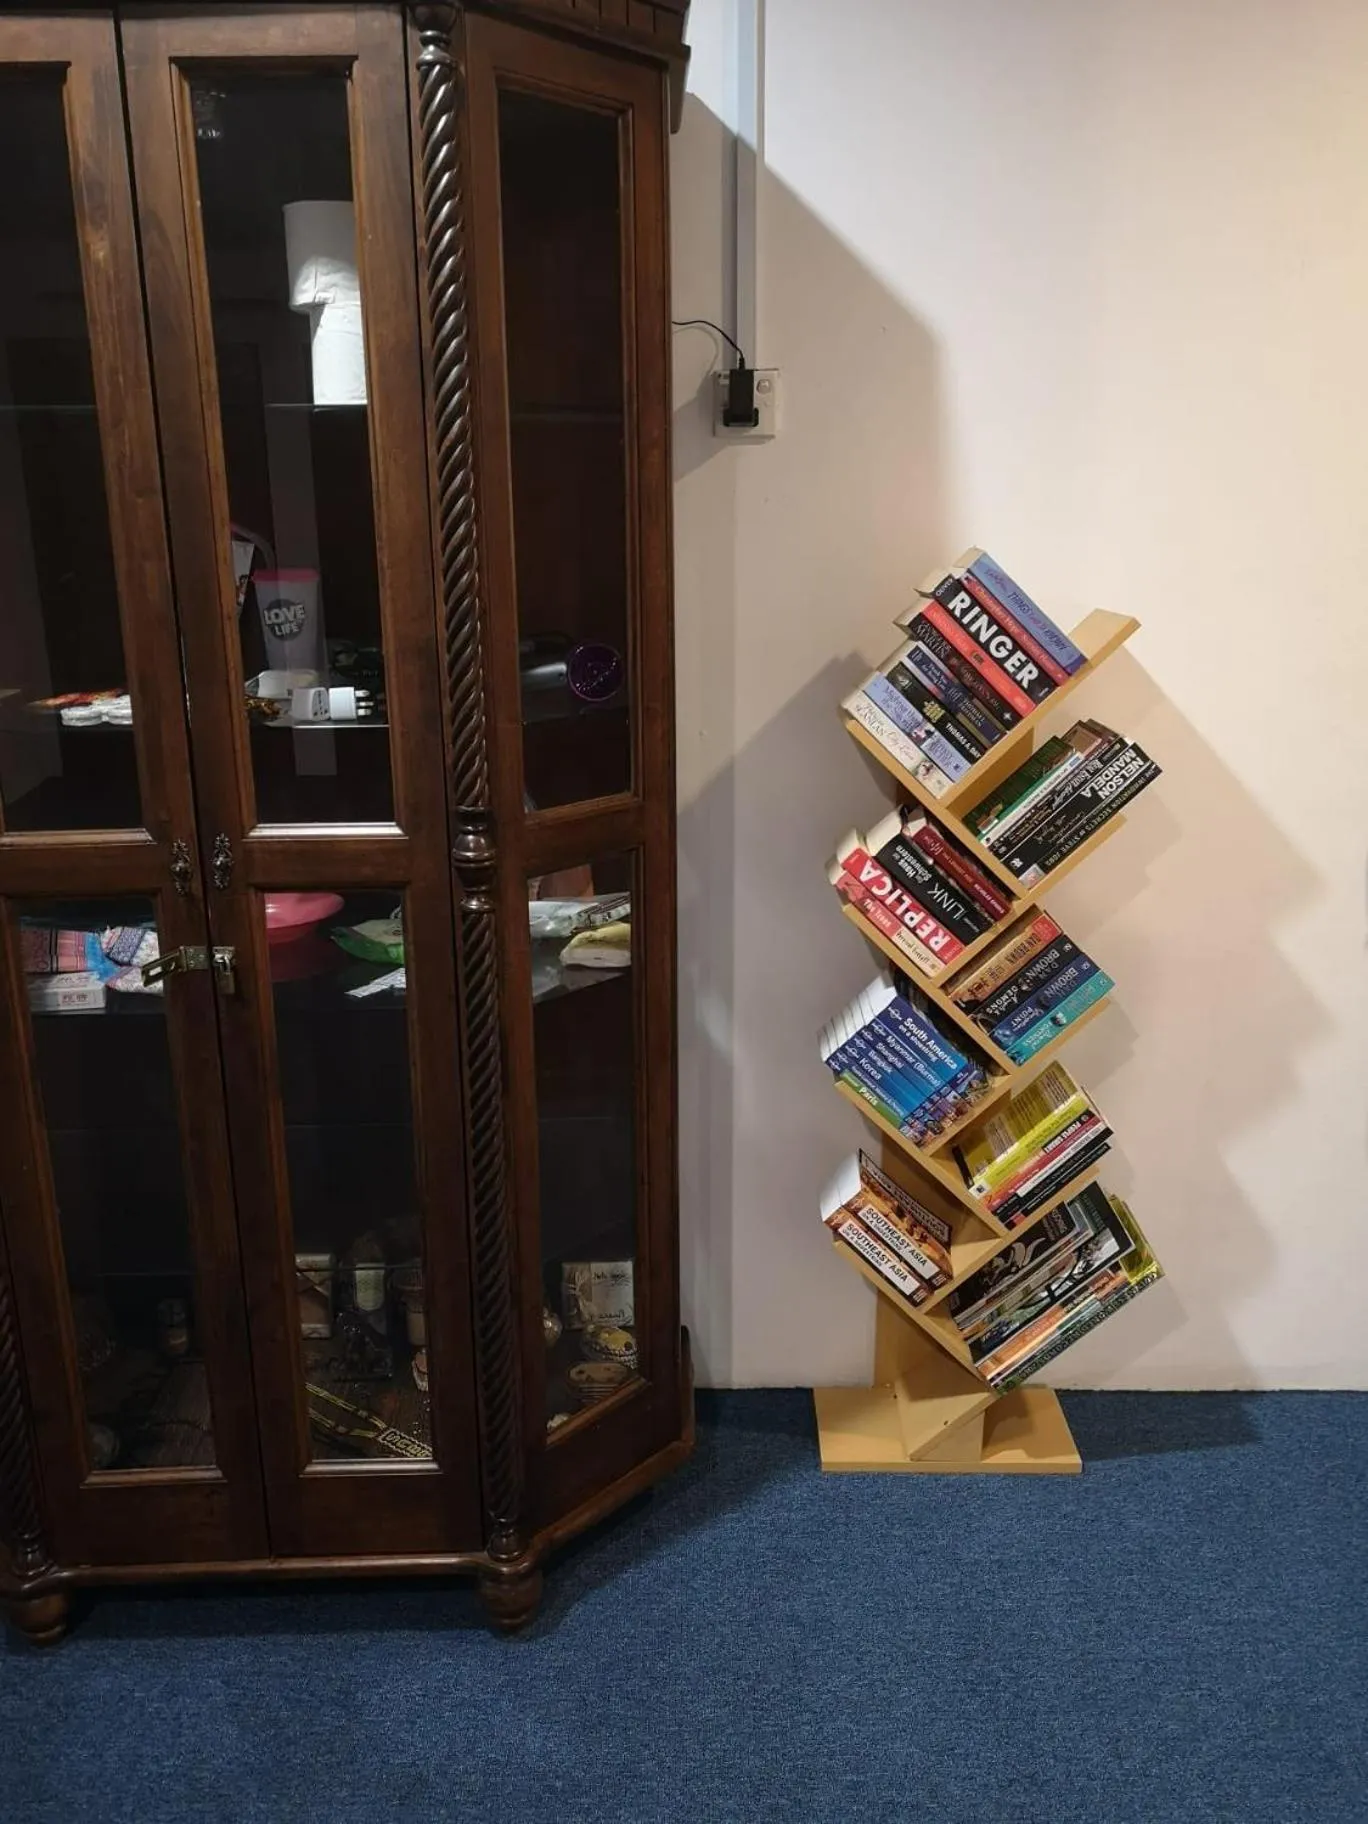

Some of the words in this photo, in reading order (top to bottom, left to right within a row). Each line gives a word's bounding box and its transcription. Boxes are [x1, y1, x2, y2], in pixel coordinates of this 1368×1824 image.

[264, 605, 304, 625] LOVE
[274, 621, 300, 636] LIFE
[946, 590, 1042, 689] RINGER
[944, 722, 966, 744] THOMAS
[968, 746, 981, 759] DAY
[1079, 747, 1137, 800] MANDELA
[1096, 755, 1144, 799] NELSON
[1109, 775, 1146, 809] INNOVATION
[1084, 806, 1111, 831] SECRETS
[1043, 850, 1062, 867] JOBS
[1059, 833, 1080, 853] STEVE
[894, 843, 932, 881] Schwestern
[896, 858, 916, 877] Haus
[854, 858, 951, 952] REPLICA
[862, 899, 876, 912] The
[874, 909, 893, 928] Trees
[927, 881, 965, 919] LINK
[1024, 947, 1059, 980] BROWN
[1037, 960, 1058, 980] DAN
[1042, 966, 1077, 998] BROWN
[985, 984, 1018, 1014] DEMONS
[1009, 1005, 1033, 1027] POINT
[874, 1041, 904, 1070] Shanghai
[898, 1024, 908, 1033] on
[909, 1034, 938, 1062] shoestring
[902, 1016, 930, 1043] South
[925, 1038, 959, 1071] America
[858, 1057, 882, 1080] Korea
[866, 1048, 894, 1075] Bangkok
[884, 1034, 917, 1065] Myanmar
[912, 1061, 941, 1089] (Burma)
[858, 1086, 879, 1106] Paris
[842, 1228, 850, 1236] ON
[861, 1212, 869, 1220] ON
[873, 1223, 902, 1250] SHOESTRING
[865, 1207, 910, 1250] SOUTHEAST
[908, 1247, 928, 1266] ASIA
[846, 1223, 891, 1266] SOUTHEAST
[888, 1262, 908, 1282] ASIA
[1078, 1304, 1113, 1334] WORLD
[1038, 1329, 1080, 1365] RECORDS
